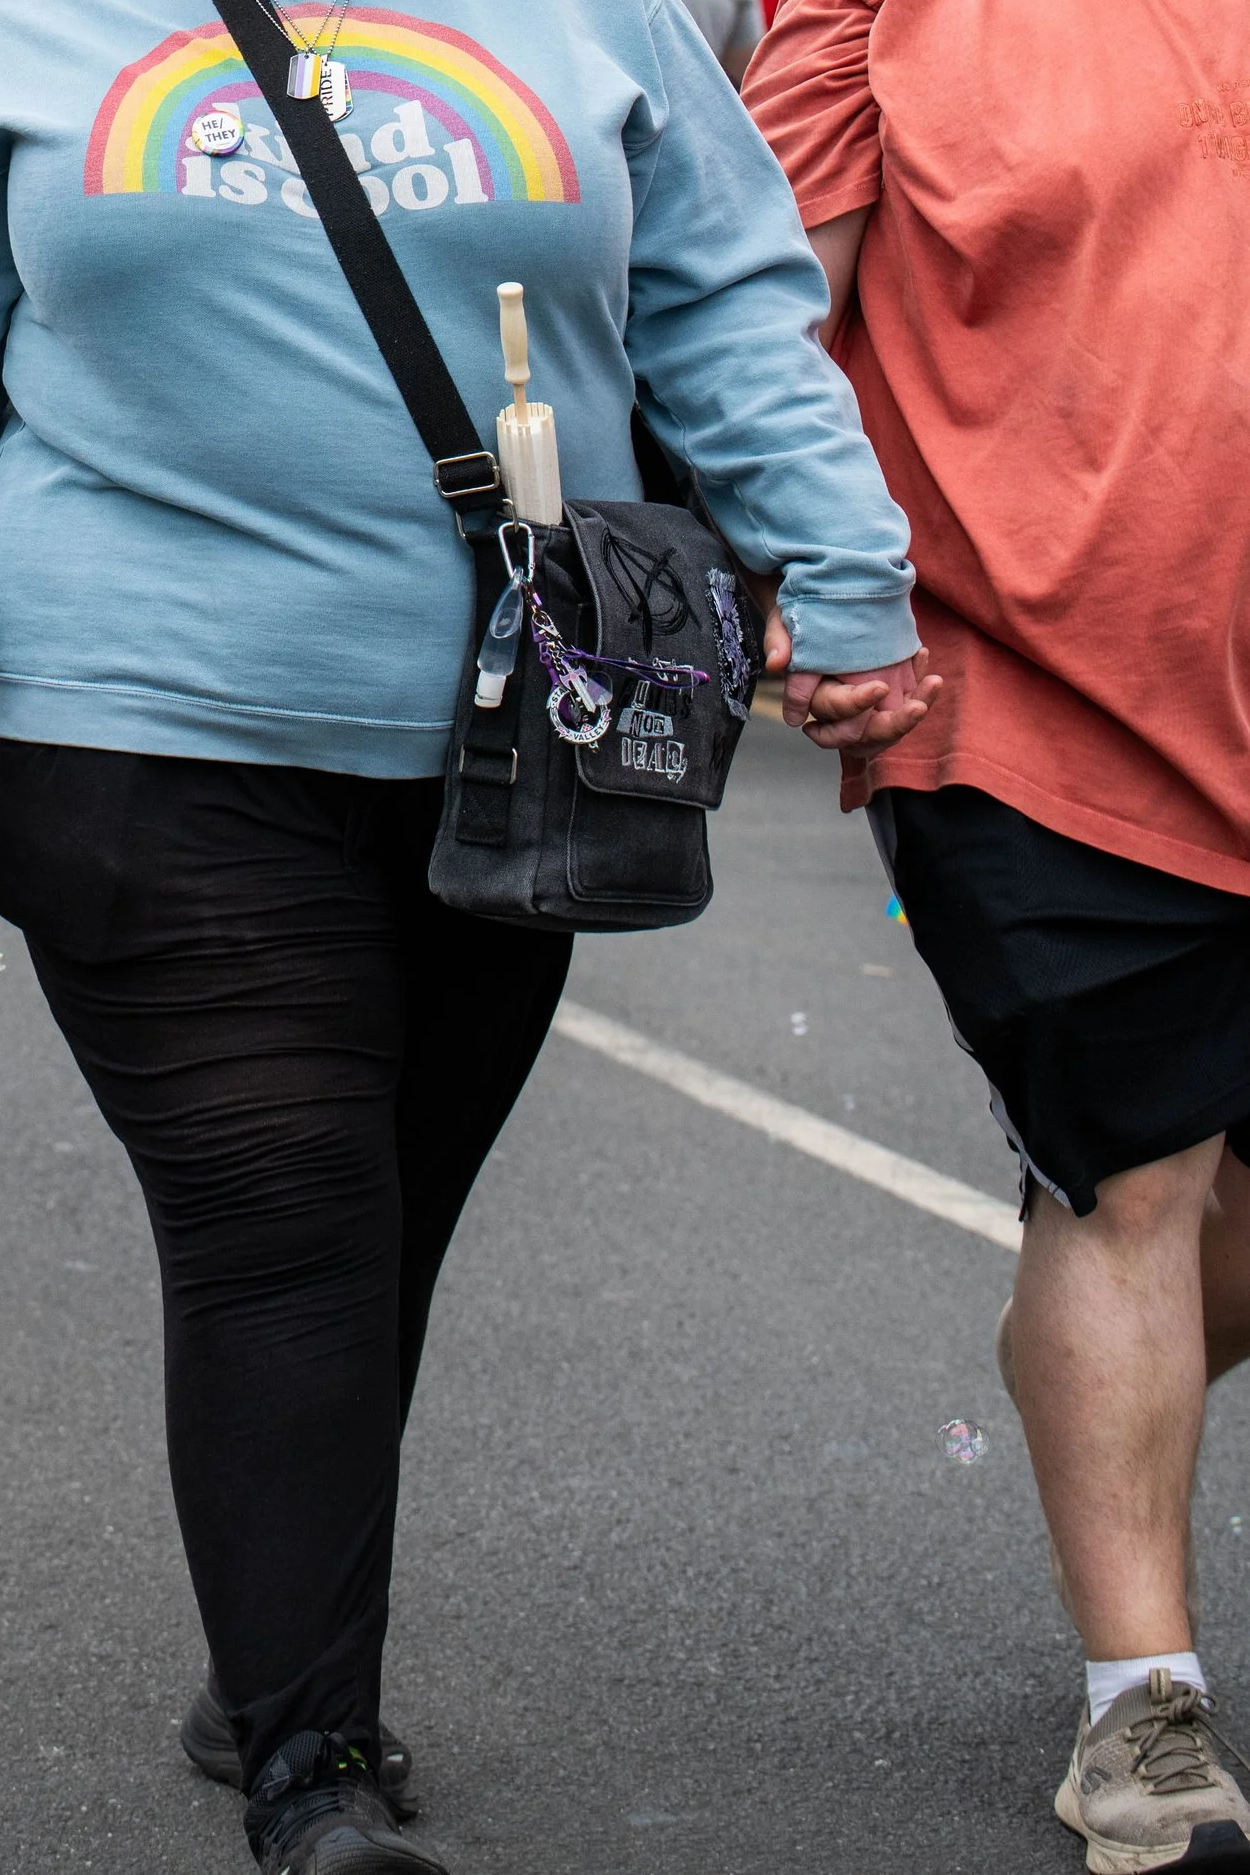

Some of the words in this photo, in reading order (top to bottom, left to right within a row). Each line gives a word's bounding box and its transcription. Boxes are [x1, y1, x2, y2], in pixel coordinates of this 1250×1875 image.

[201, 117, 224, 131] HE/
[205, 128, 236, 143] THEY
[573, 725, 604, 741] VALLEY
